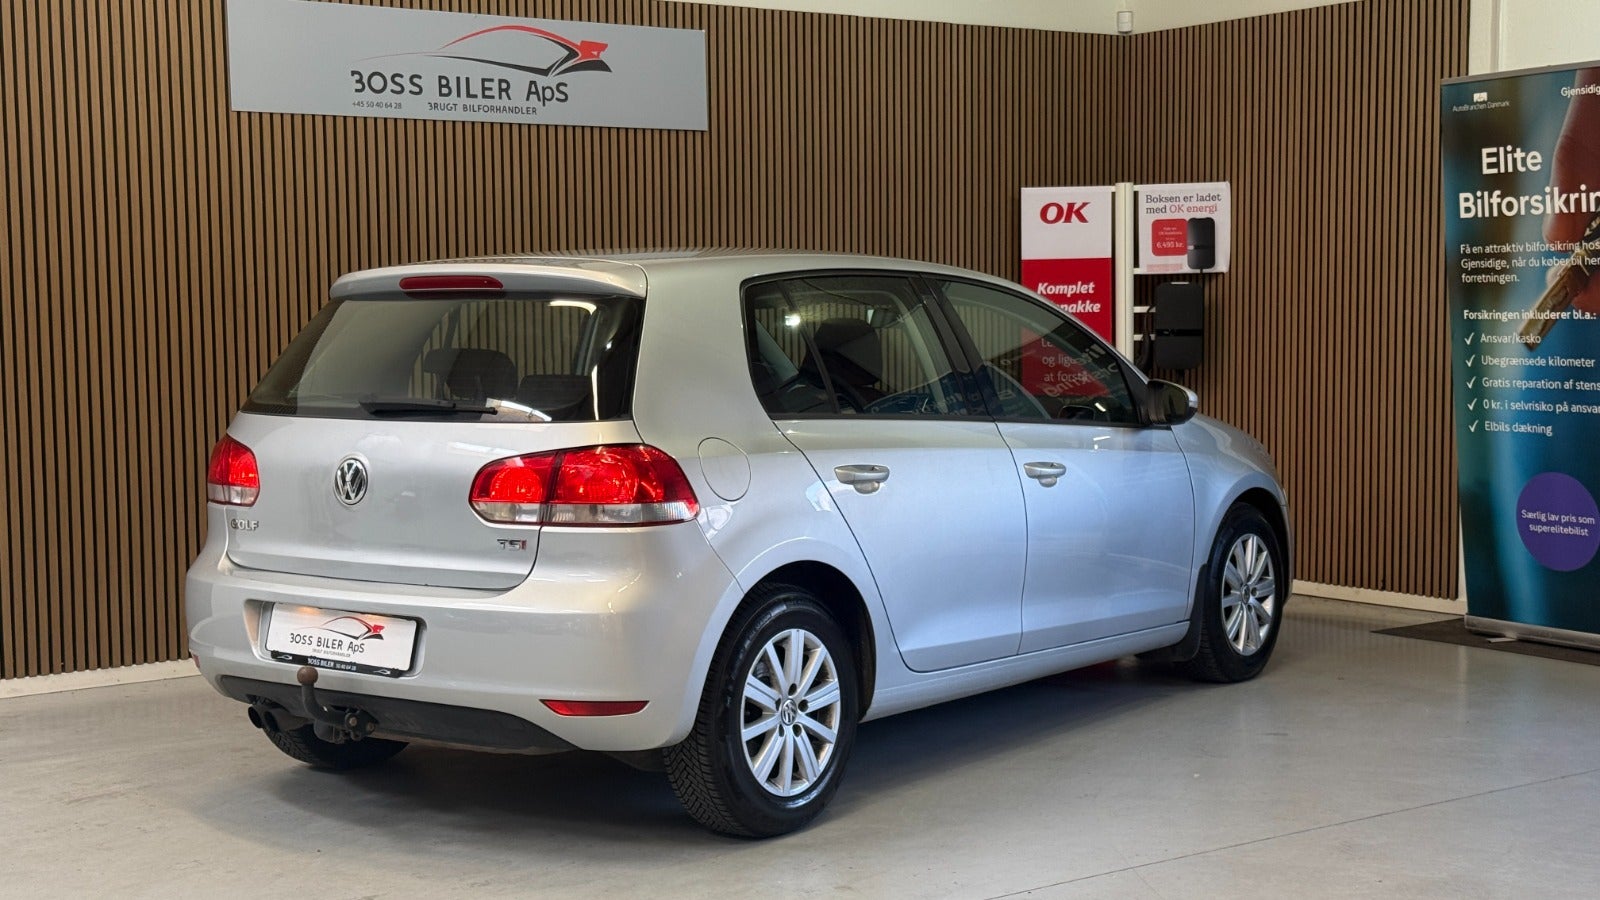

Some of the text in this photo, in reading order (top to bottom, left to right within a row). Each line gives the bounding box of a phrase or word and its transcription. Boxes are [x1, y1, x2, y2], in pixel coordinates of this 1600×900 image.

[438, 75, 512, 101] BILER
[525, 80, 569, 107] ApS
[463, 104, 537, 115] BILFORHANDLER
[1481, 145, 1542, 175] Elite
[1145, 193, 1222, 204] Boksen er ladet
[1040, 202, 1091, 224] OK
[1146, 203, 1218, 214] med OK energi
[1460, 240, 1600, 254] Få en attraktiv bilforsikring hos
[1461, 258, 1510, 270] Gjensidige,
[1511, 257, 1526, 267] når
[1528, 257, 1540, 267] du
[1541, 256, 1568, 266] køber
[1461, 273, 1520, 284] forretningen.
[1037, 281, 1096, 298] Komplet
[1463, 310, 1520, 322] Forsikringen
[1521, 309, 1570, 320] inkluderer
[1480, 333, 1542, 344] Ansvar/kasko
[1481, 355, 1596, 368] Ubegrænsede kilometer
[1482, 377, 1511, 388] Gratis
[1512, 378, 1561, 390] reparation
[1563, 379, 1573, 389] af
[1483, 399, 1489, 409] 0
[1491, 400, 1503, 410] kr.
[1510, 401, 1554, 412] selvrisiko
[1555, 401, 1569, 414] på
[1484, 421, 1553, 436] Elbils dækning
[1521, 509, 1595, 525] Særlig lav pris som
[231, 518, 259, 531] GOLF
[1529, 524, 1589, 537] superelitebilist
[316, 637, 343, 650] BILER
[347, 641, 365, 655] ApS
